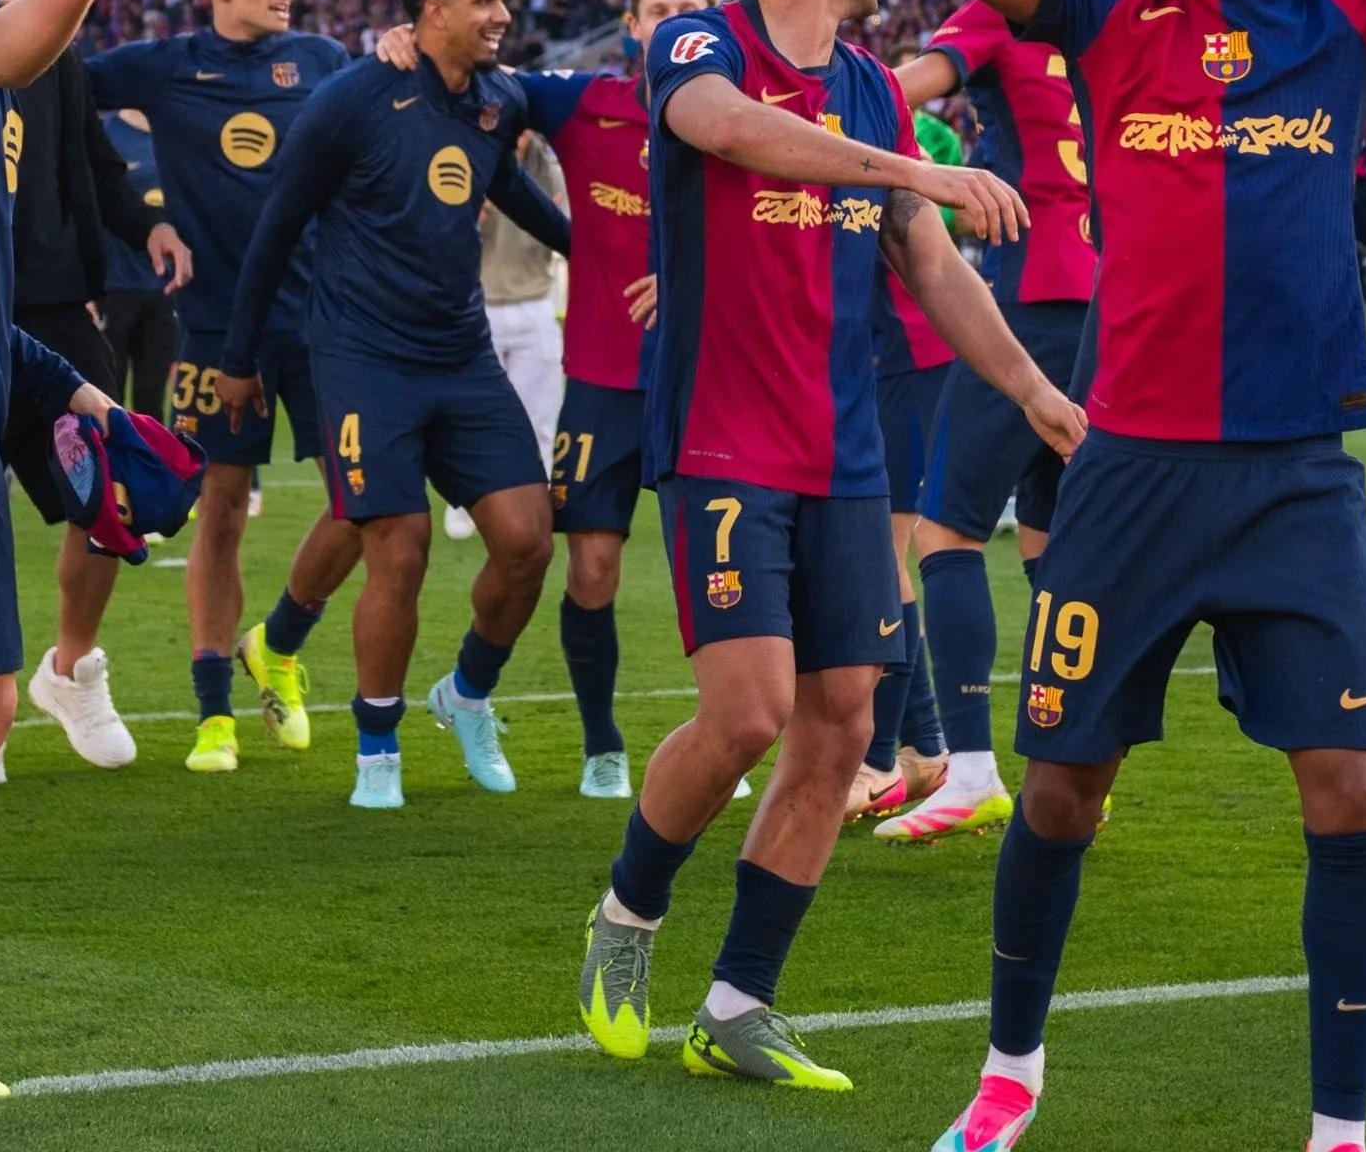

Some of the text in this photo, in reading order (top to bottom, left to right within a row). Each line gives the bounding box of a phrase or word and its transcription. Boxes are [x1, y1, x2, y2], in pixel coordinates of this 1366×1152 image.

[172, 362, 223, 415] 35
[338, 413, 362, 463] 4
[704, 497, 743, 563] 7
[1030, 590, 1099, 681] 19
